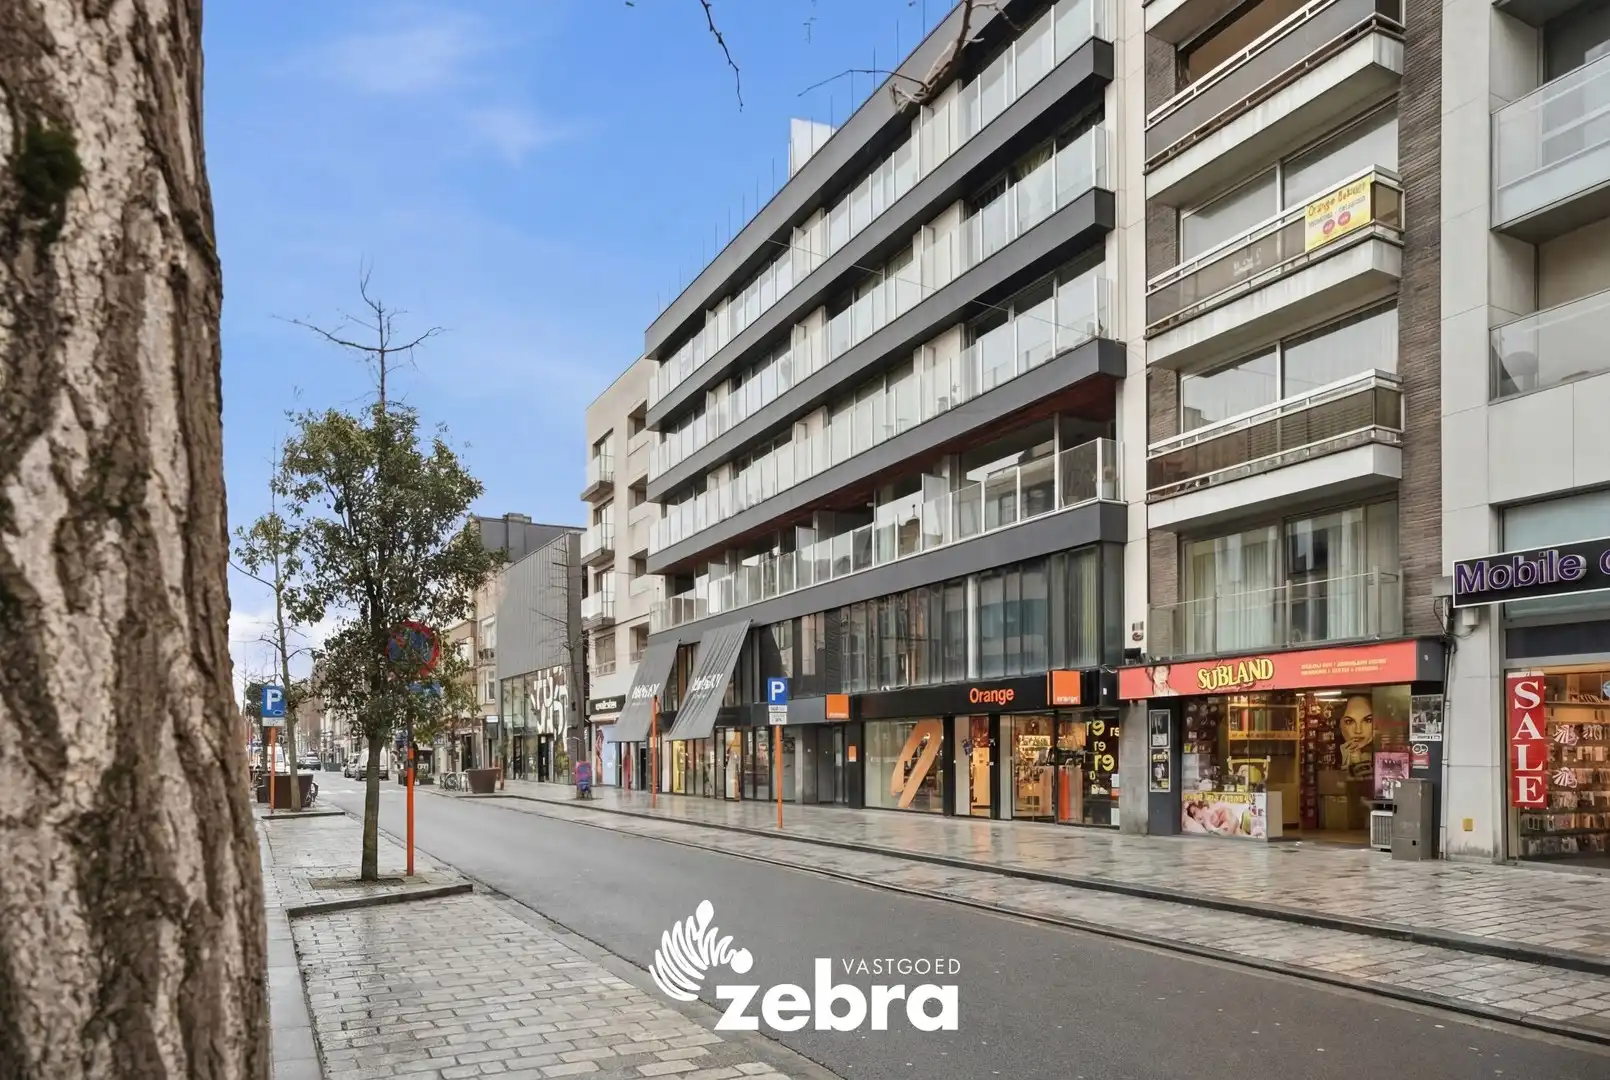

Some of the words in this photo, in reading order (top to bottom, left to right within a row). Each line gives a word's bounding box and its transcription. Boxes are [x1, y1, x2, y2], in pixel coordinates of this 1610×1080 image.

[1455, 549, 1587, 595] Mobile
[1197, 658, 1274, 690] SUBLAND
[266, 689, 283, 710] P
[771, 681, 786, 701] P
[969, 687, 1015, 706] Orange
[1511, 681, 1545, 804] SALE
